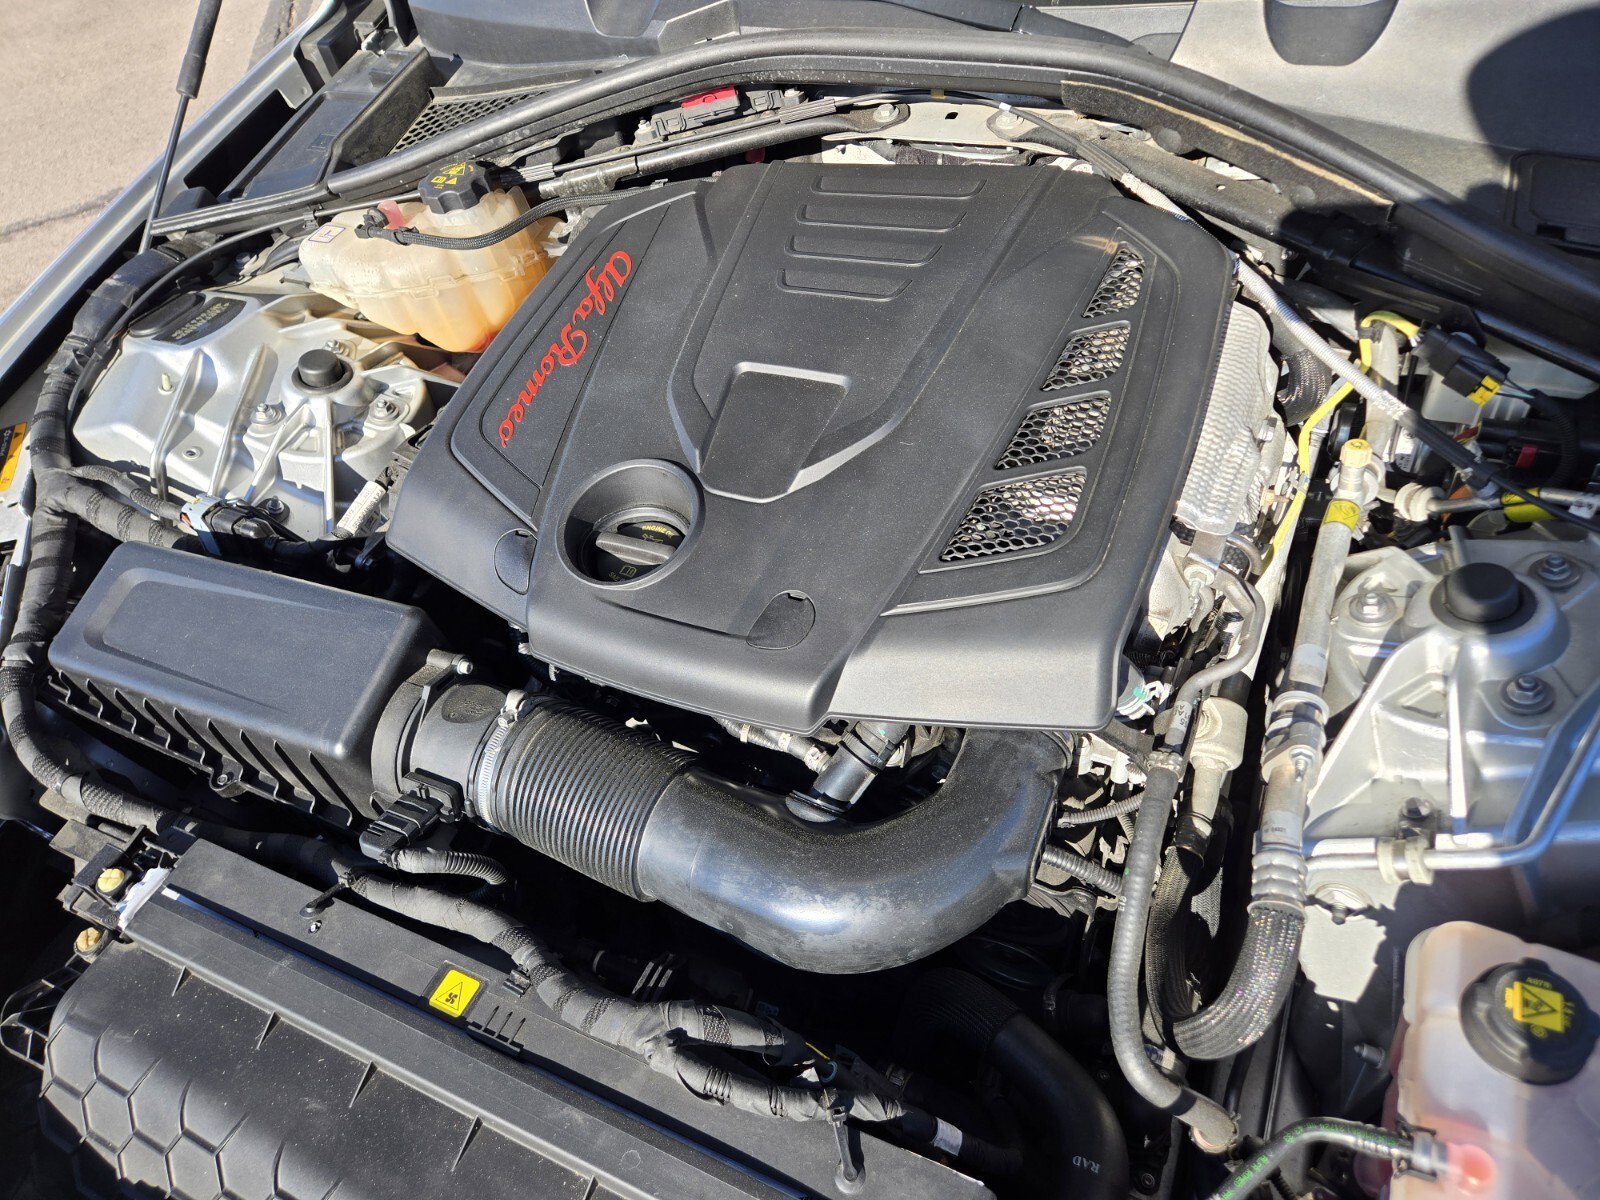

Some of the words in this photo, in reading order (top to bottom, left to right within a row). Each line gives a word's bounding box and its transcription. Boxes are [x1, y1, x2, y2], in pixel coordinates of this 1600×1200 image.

[572, 251, 632, 325] Alfa
[498, 323, 588, 448] Romeo
[641, 525, 667, 533] ENGINE
[1071, 1156, 1100, 1174] RAD
